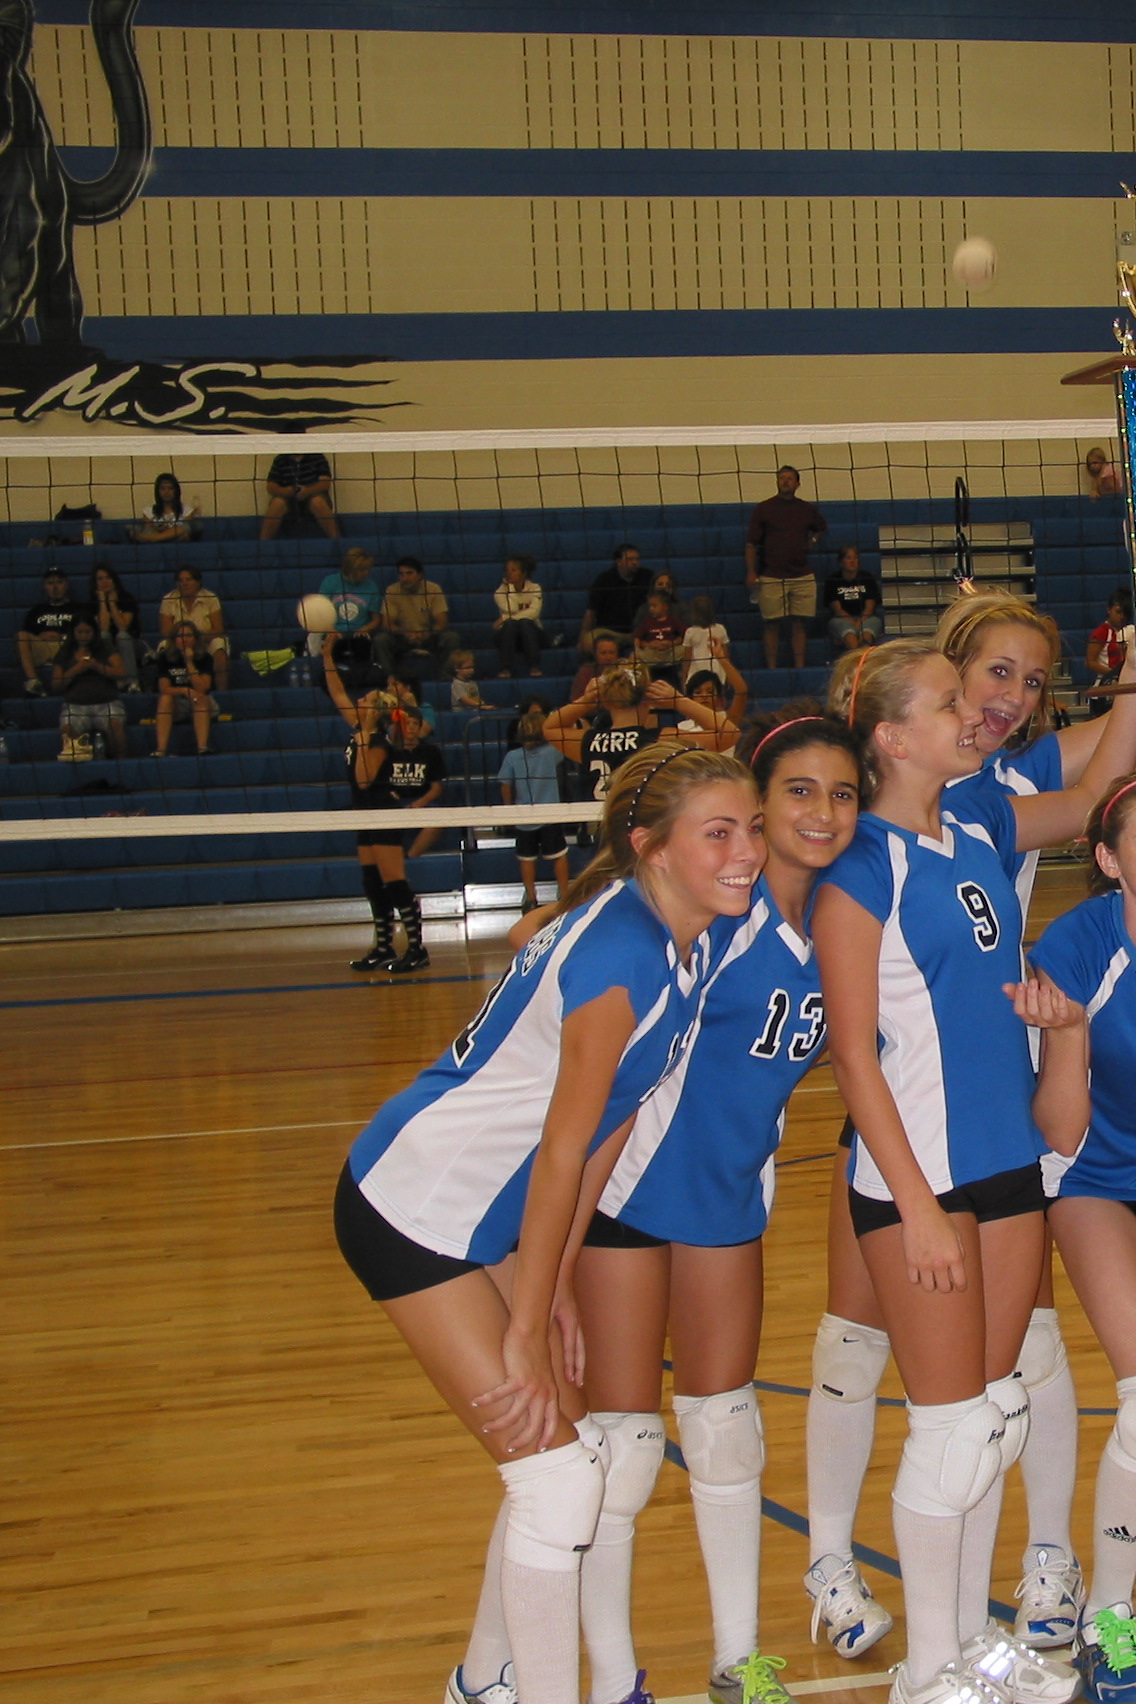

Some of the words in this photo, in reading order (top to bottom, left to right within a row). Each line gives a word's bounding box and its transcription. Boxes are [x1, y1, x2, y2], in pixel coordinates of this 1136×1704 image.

[589, 731, 639, 753] KERR
[392, 763, 427, 779] ELK
[957, 880, 1000, 952] 9
[749, 988, 828, 1062] 13
